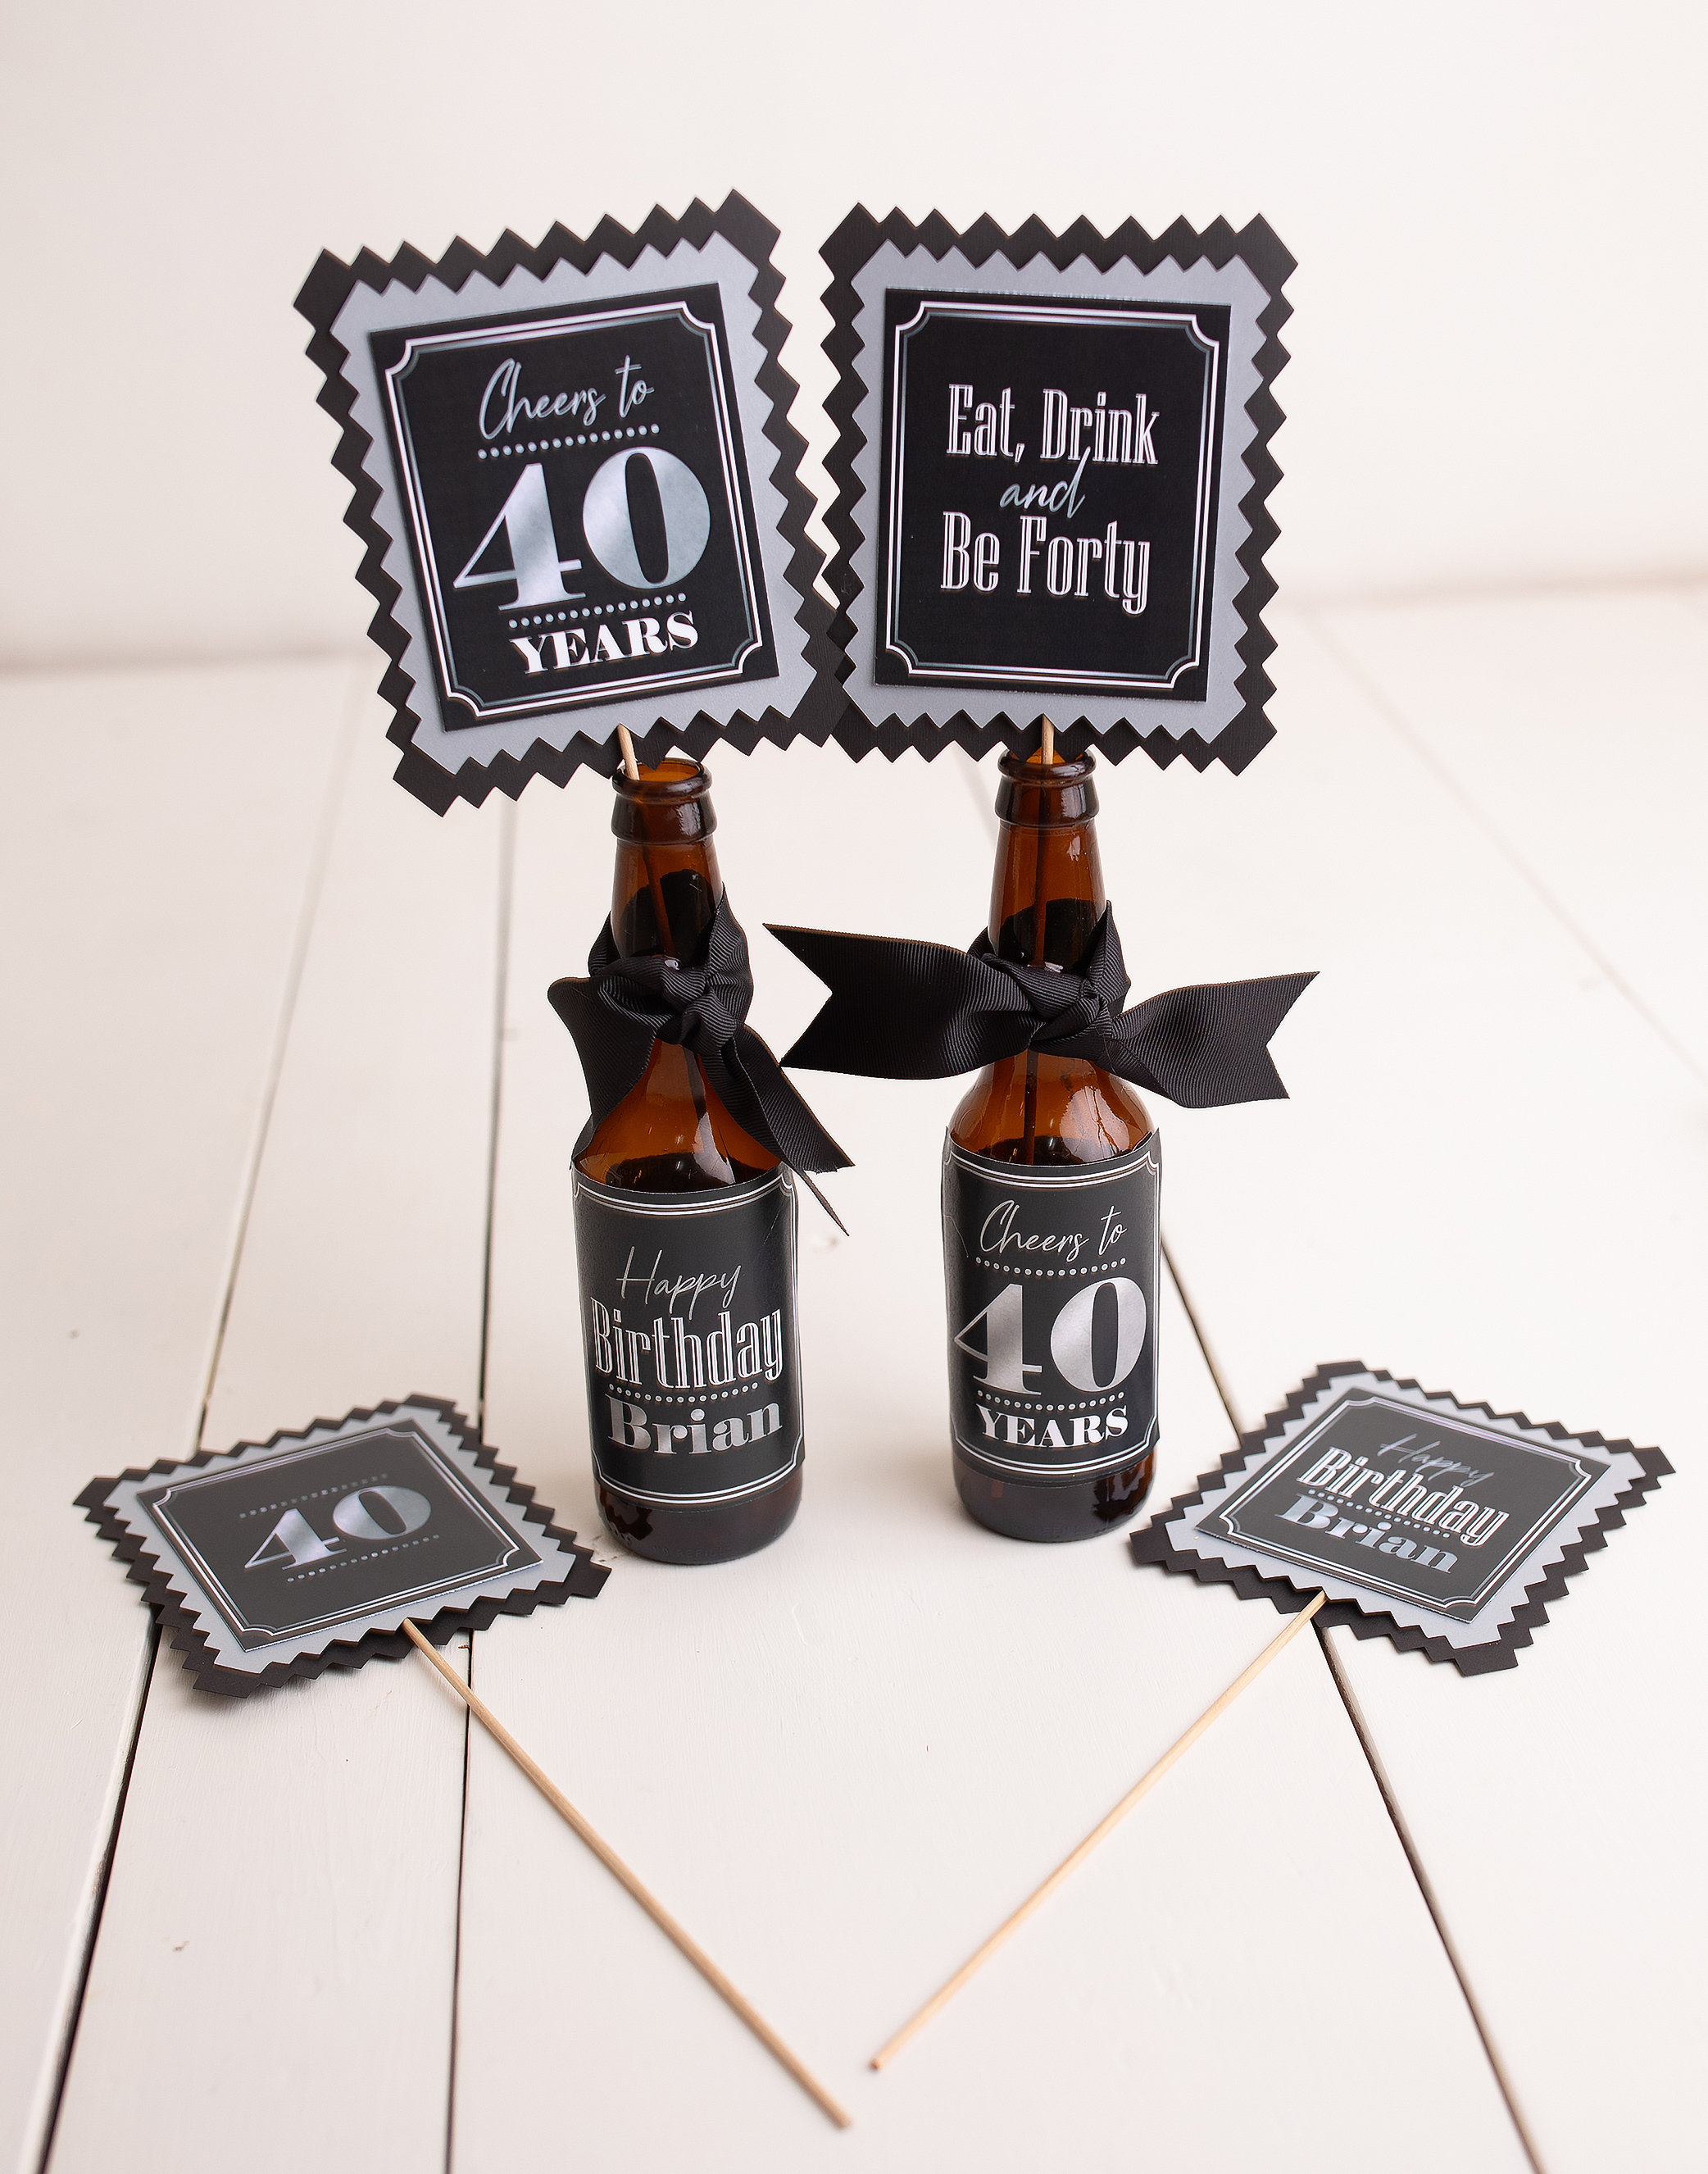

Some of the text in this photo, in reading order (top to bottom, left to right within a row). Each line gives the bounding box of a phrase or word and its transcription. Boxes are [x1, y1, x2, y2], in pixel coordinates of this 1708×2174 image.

[479, 355, 655, 439] Cheers to
[946, 384, 1160, 465] Eat, Drink
[1000, 446, 1091, 518] and
[452, 446, 711, 611] 40
[940, 511, 1150, 614] Be Forty
[510, 611, 698, 674] YEARS
[979, 1199, 1127, 1262] Cheers to
[616, 1245, 742, 1320] Happy
[590, 1297, 783, 1389] Birthday
[953, 1276, 1147, 1395] 40
[604, 1394, 783, 1454] Brian
[975, 1403, 1129, 1449] YEARS
[1378, 1433, 1496, 1485] Happy
[245, 1485, 432, 1571] 40
[1274, 1494, 1460, 1574] Brian
[1297, 1446, 1510, 1547] Birthday
